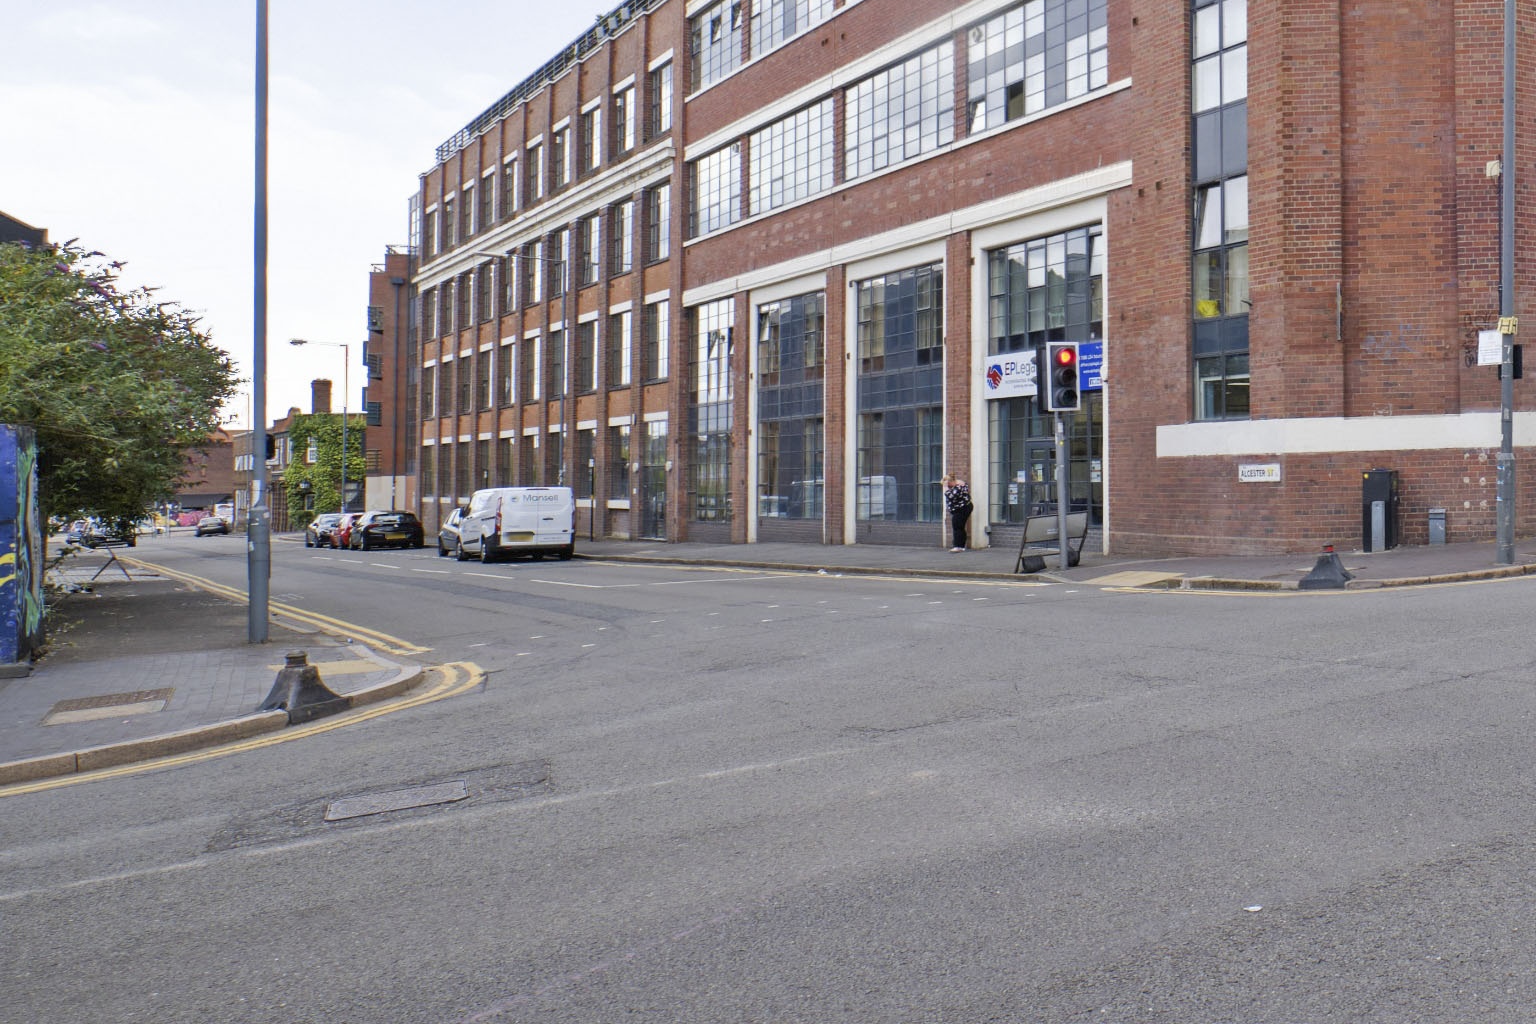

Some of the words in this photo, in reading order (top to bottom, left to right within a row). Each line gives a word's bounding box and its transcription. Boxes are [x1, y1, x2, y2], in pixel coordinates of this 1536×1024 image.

[1004, 361, 1036, 376] EPLega
[1241, 469, 1265, 477] ALCESTER
[523, 494, 558, 502] Mansell
